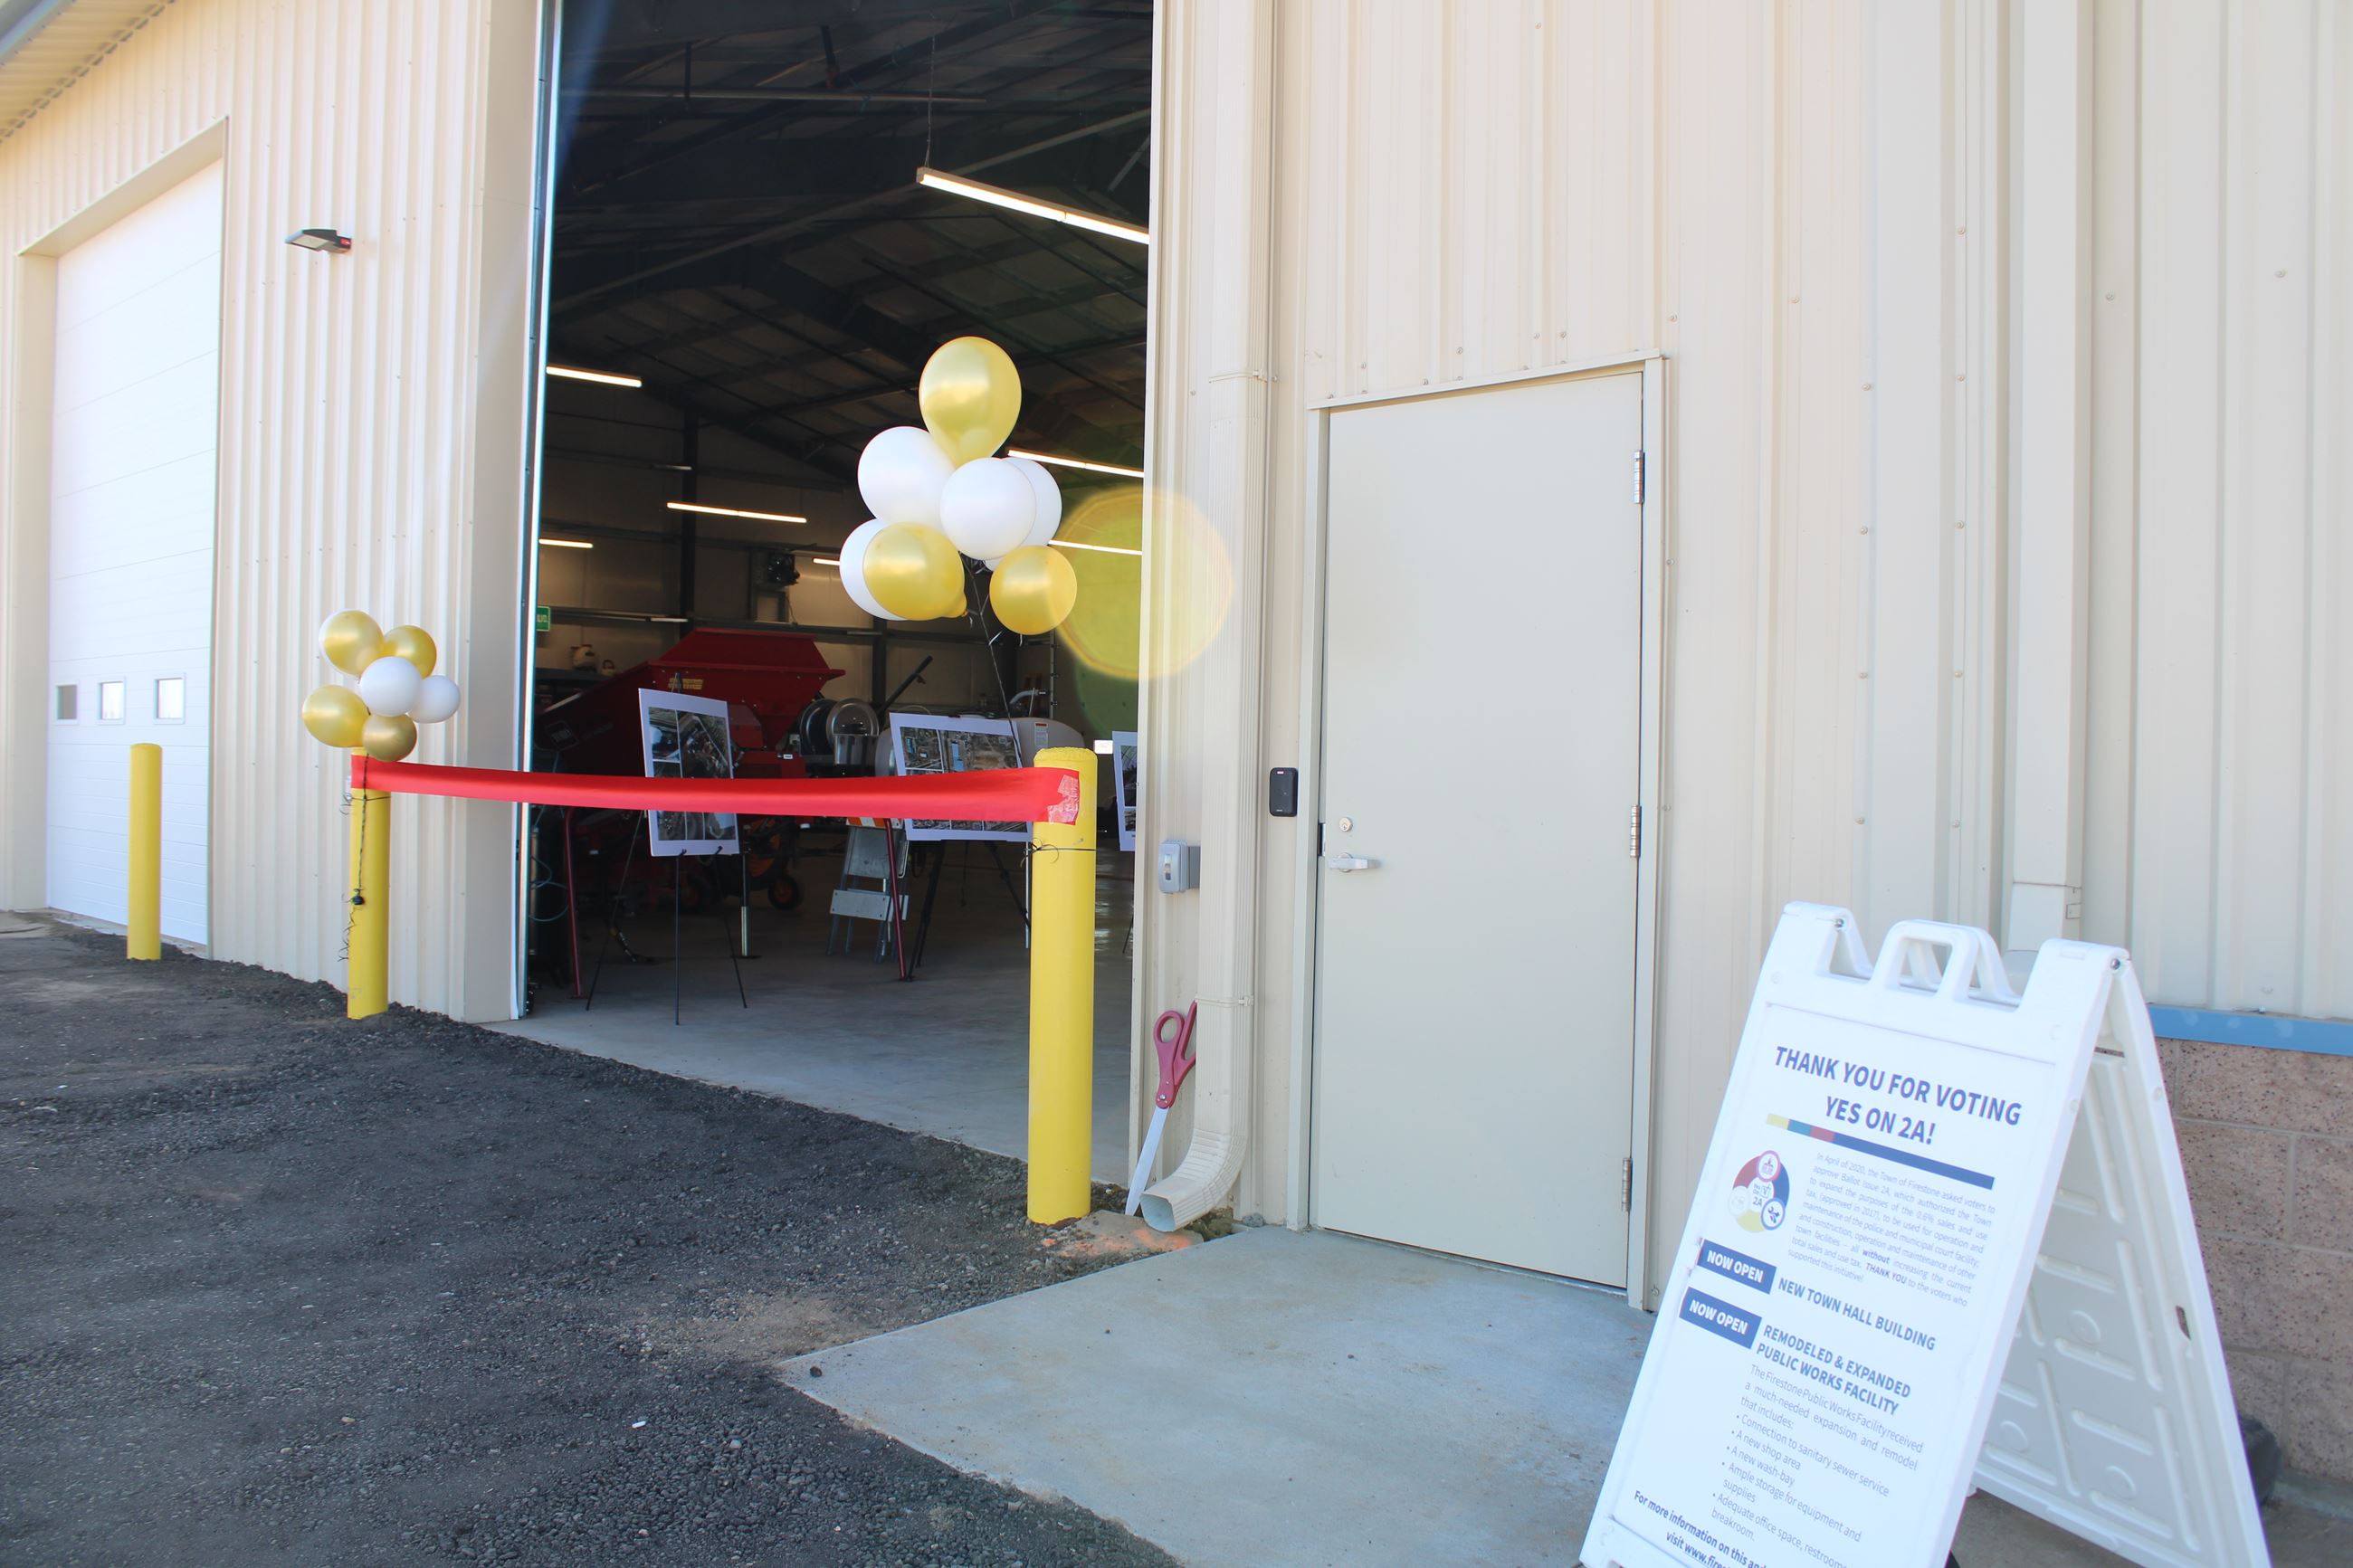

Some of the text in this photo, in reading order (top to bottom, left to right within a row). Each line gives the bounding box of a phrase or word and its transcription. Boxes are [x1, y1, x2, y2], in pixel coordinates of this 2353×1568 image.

[1776, 1046, 2022, 1126] THANK YOU FOR VOTING
[1826, 1096, 1936, 1145] YES ON 2A!
[1752, 1196, 1763, 1207] 2A
[1707, 1250, 1764, 1283] NOW OPEN
[1862, 1250, 1890, 1264] without
[1867, 1262, 1890, 1278] THANK
[1891, 1273, 1907, 1284] YOU
[1690, 1299, 1748, 1335] NOW OPEN
[1778, 1278, 1936, 1351] NEW TOWN HALL BUILDING
[1757, 1343, 1899, 1415] PUBLIC WORKS FACILITY
[1763, 1325, 1910, 1398] REMODELED & EXPANDED
[1740, 1396, 1794, 1430] that includes:
[1745, 1382, 1918, 1471] a much-needed expansion and remodel
[1751, 1364, 1924, 1454] The Firestone Public Works Facility received
[1730, 1446, 1795, 1488] A new wash-bay
[1735, 1430, 1801, 1470] A new shop area
[1741, 1414, 1889, 1497] Connection to sanitary sewer service
[1723, 1479, 1756, 1503] supplies
[1729, 1462, 1862, 1543] Ample storage for equipment and
[1634, 1490, 1648, 1506] For
[1647, 1500, 1669, 1518] more
[1669, 1513, 1718, 1548] information
[1718, 1543, 1729, 1555] on
[1730, 1548, 1748, 1565] this
[1666, 1532, 1684, 1549] visit
[1711, 1506, 1754, 1541] breakroom.
[1717, 1493, 1847, 1568] Adequate office space, restroom
